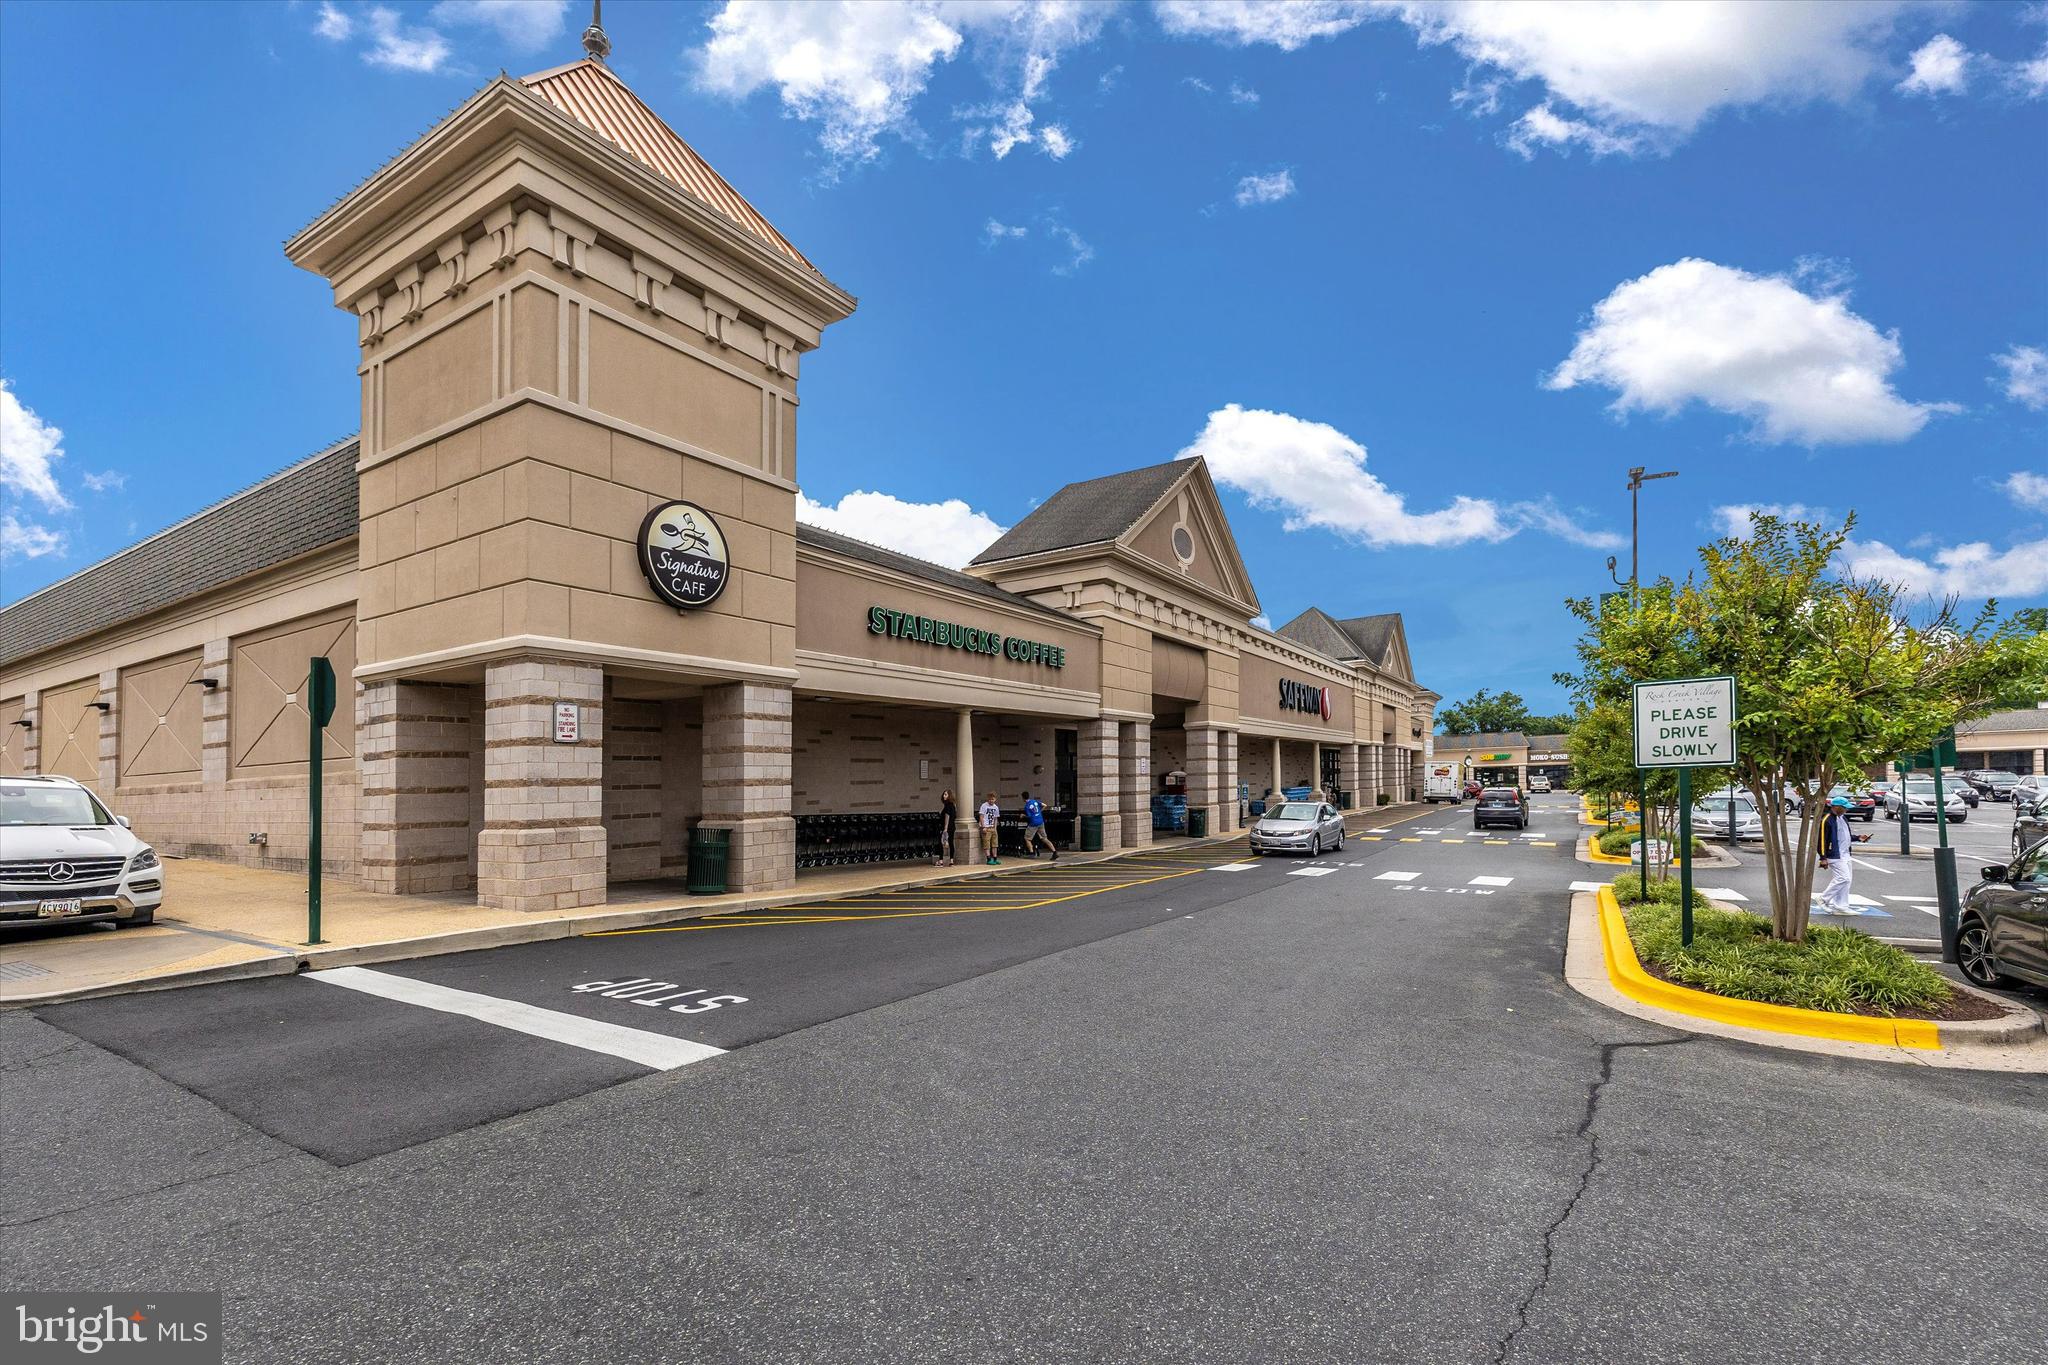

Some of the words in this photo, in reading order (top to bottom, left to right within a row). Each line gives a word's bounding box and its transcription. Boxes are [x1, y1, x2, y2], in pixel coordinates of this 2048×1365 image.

[657, 552, 721, 580] Signature
[671, 578, 706, 597] CAFE
[869, 606, 1001, 656] STARBUCKS
[1004, 636, 1065, 668] COFFEE
[1693, 683, 1722, 697] Village
[1651, 706, 1718, 722] PLEASE
[1660, 725, 1708, 739] DRIVE
[1652, 743, 1718, 758] SLOWLY
[1392, 885, 1496, 895] SLOW
[571, 978, 749, 1014] STOP
